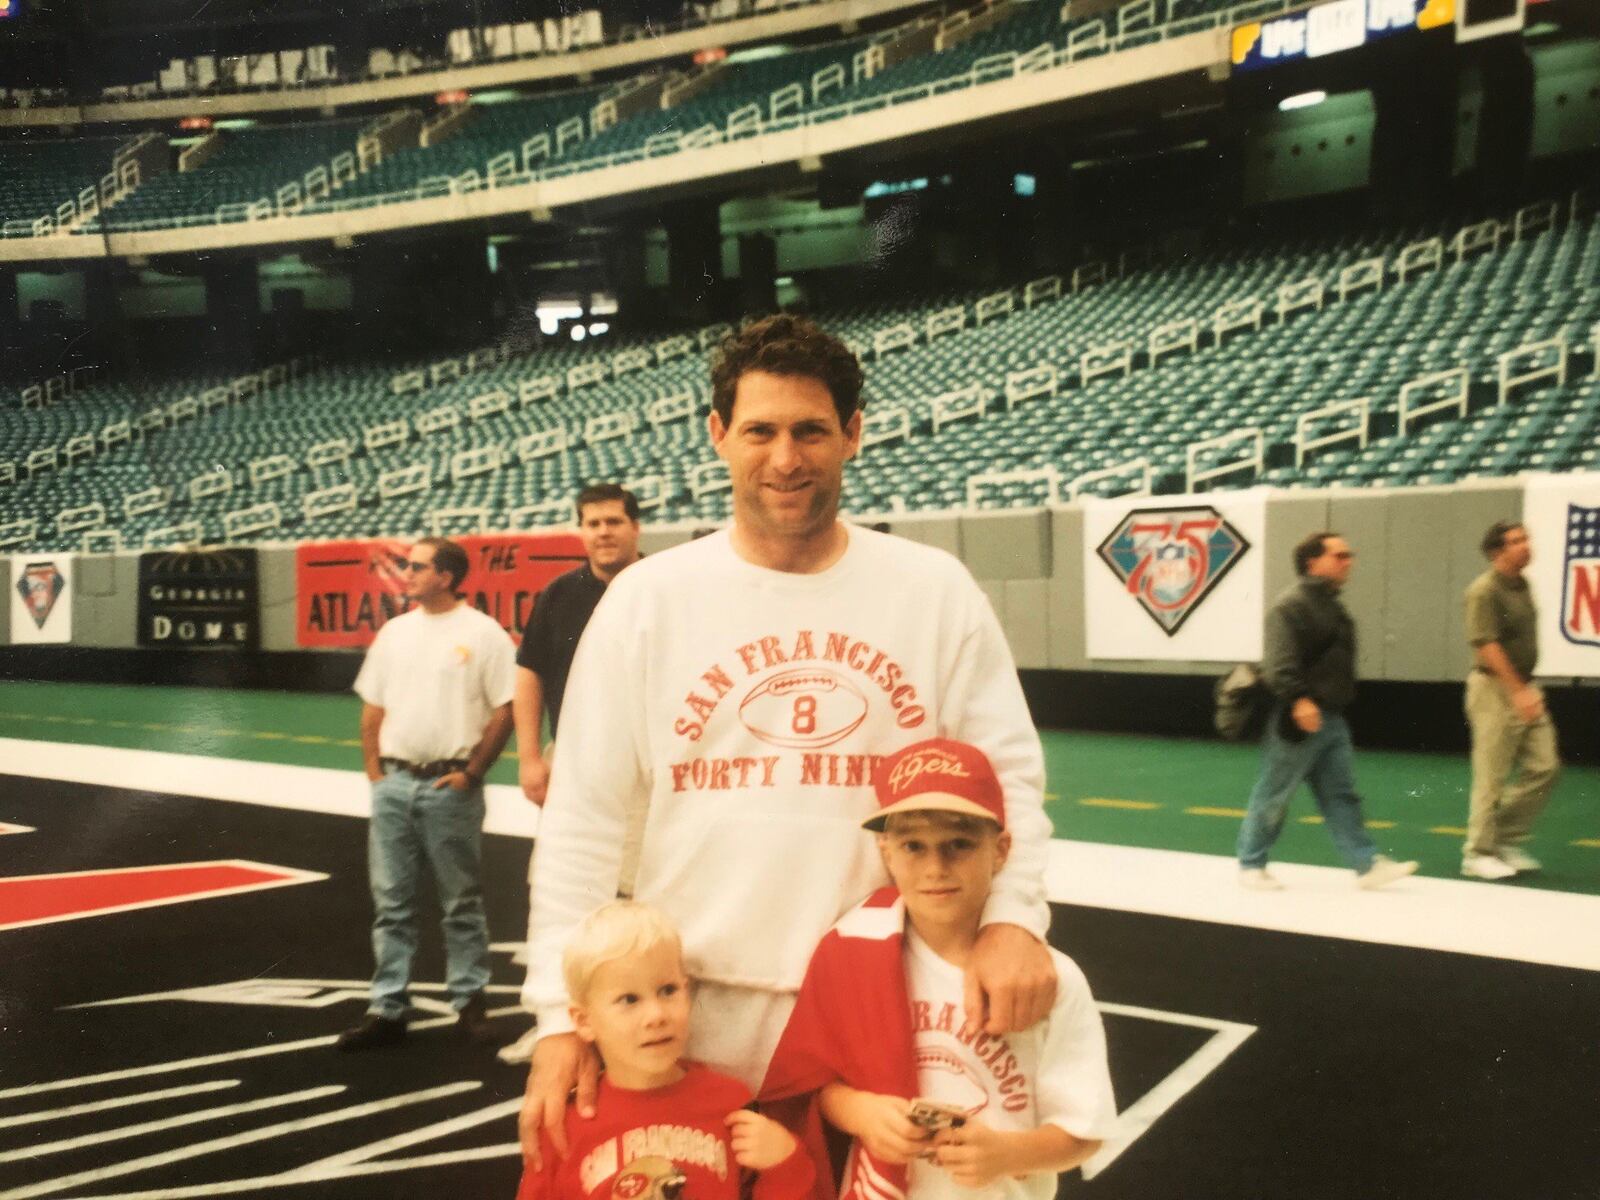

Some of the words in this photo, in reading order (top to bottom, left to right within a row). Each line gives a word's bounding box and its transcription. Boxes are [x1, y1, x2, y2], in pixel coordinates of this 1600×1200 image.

[480, 544, 521, 572] THE
[674, 664, 736, 742] SAN
[736, 630, 926, 730] FRANCISCO
[792, 695, 817, 734] 8
[669, 755, 780, 793] FORTY
[888, 757, 970, 795] 49ers
